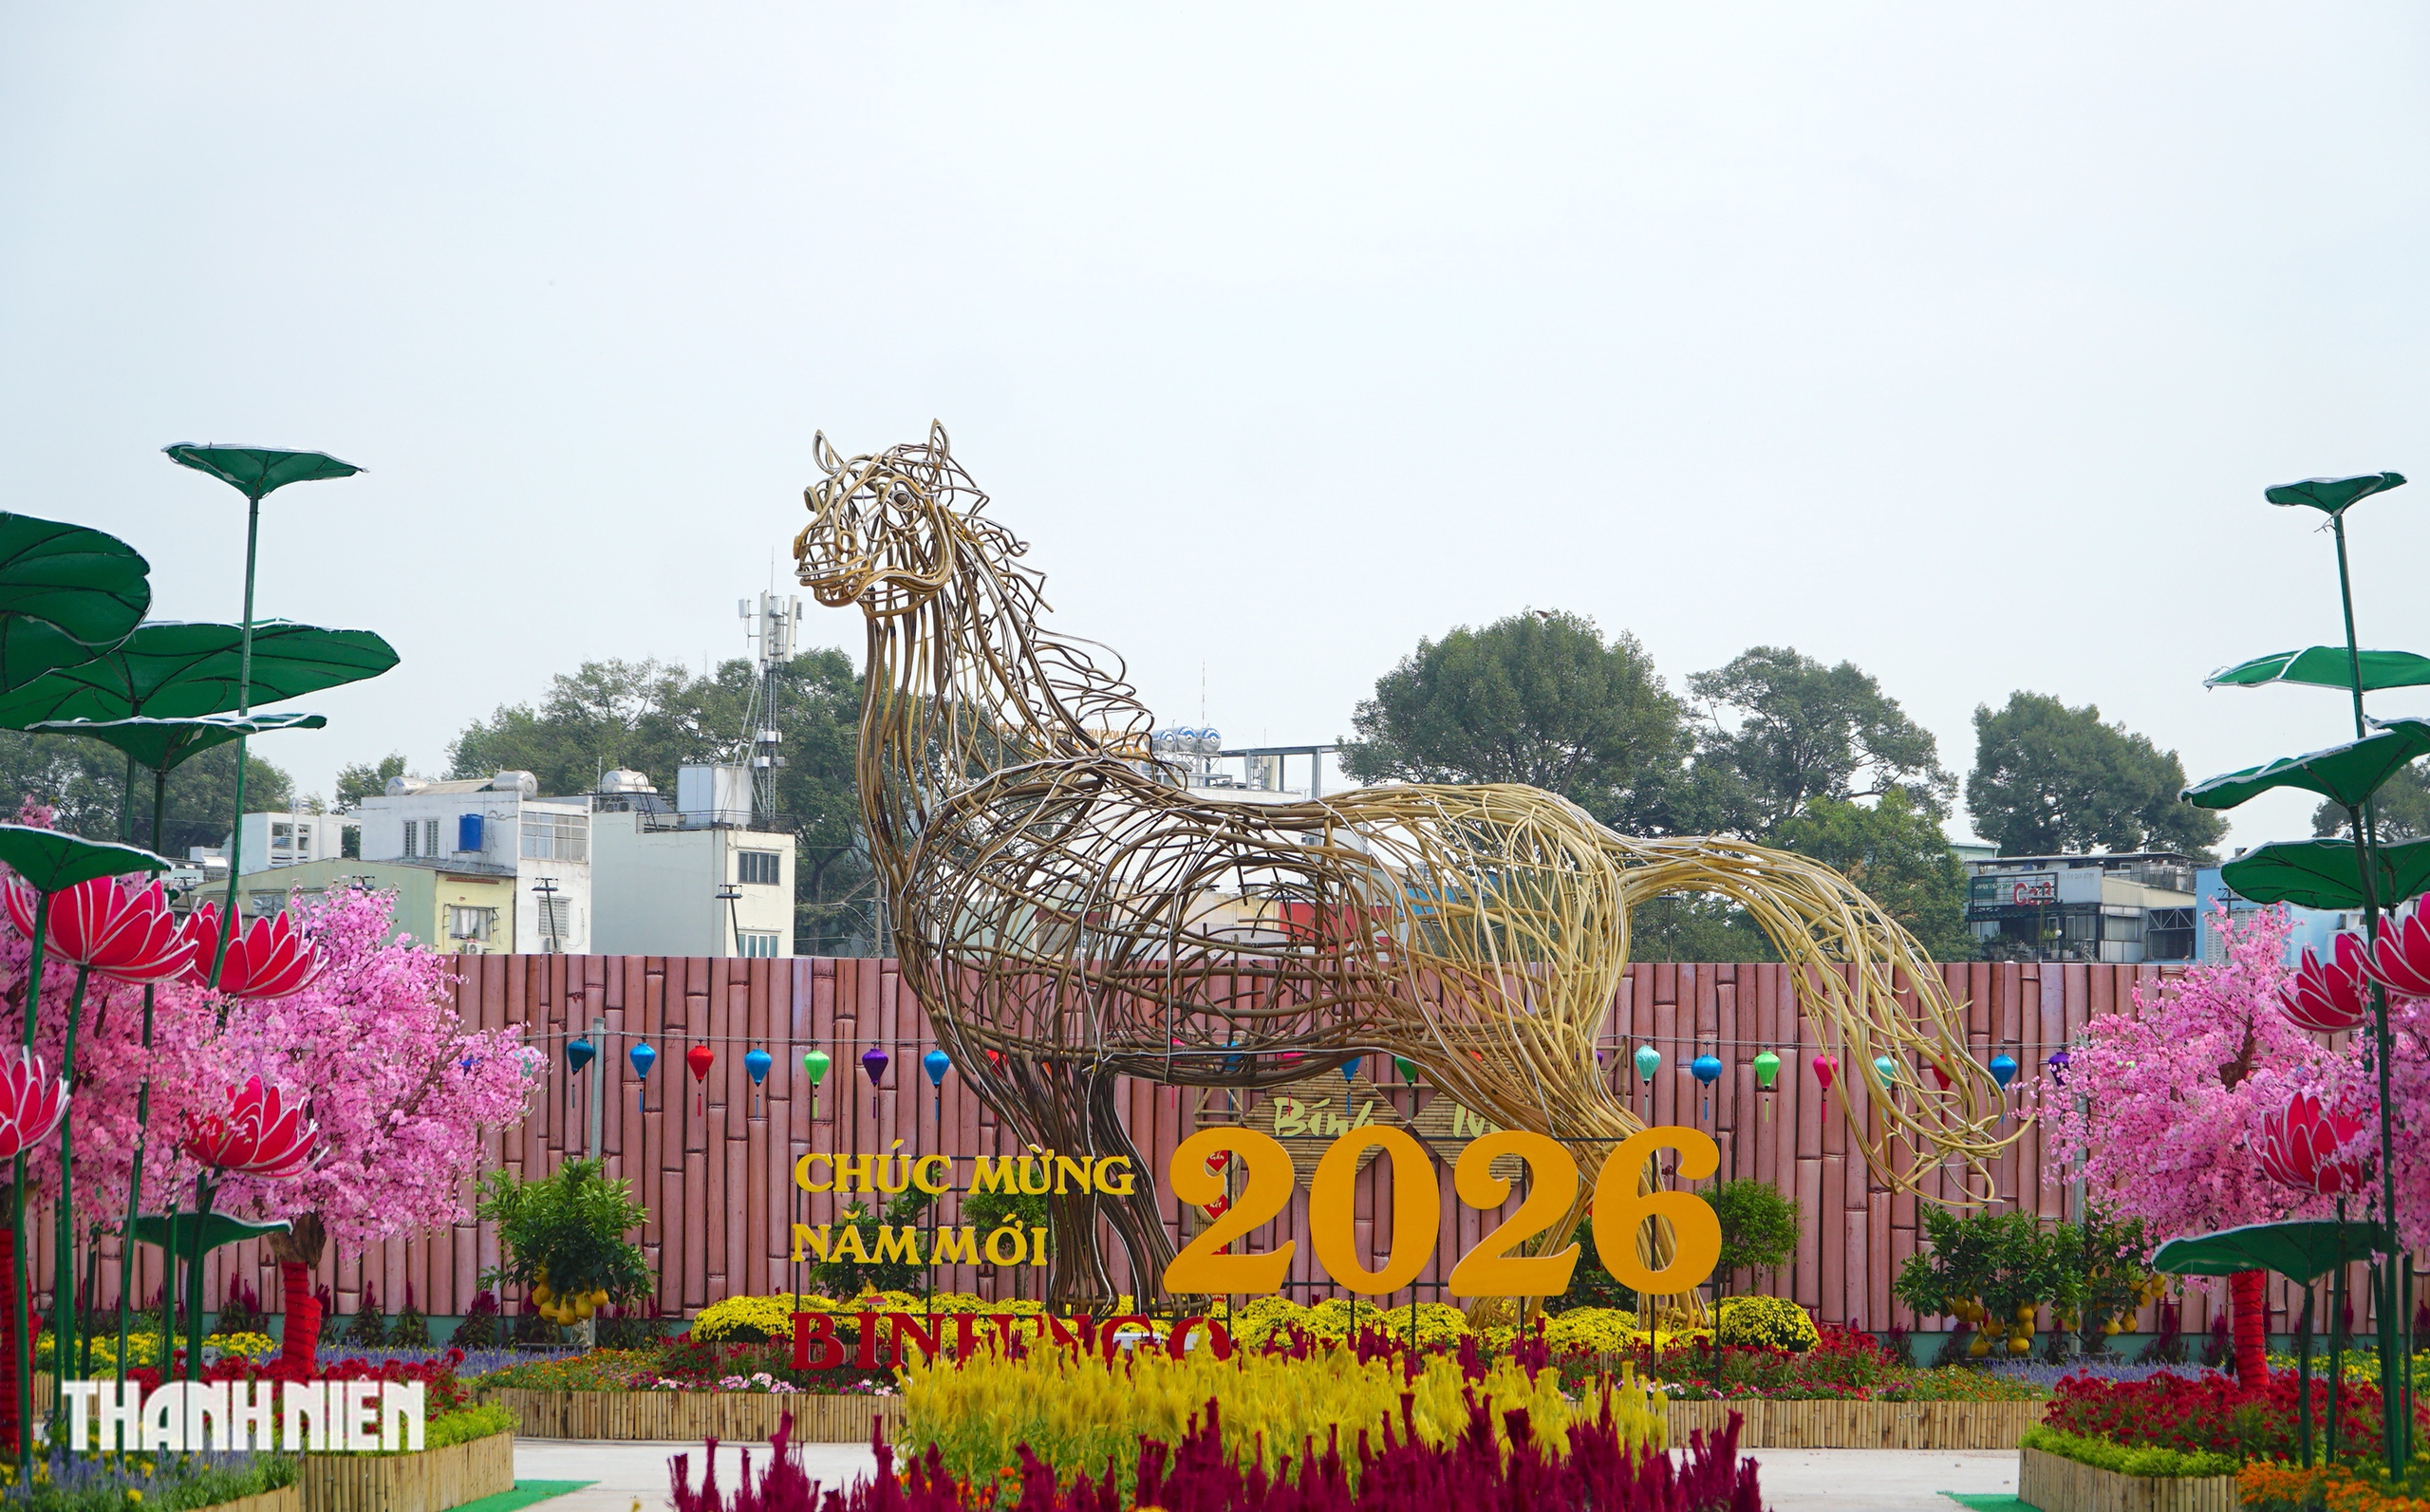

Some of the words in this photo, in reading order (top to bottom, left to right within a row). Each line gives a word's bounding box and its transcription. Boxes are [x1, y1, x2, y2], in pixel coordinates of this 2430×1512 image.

[1273, 1097, 1374, 1137] Bính
[794, 1139, 953, 1195] CHÚC
[966, 1144, 1135, 1196] MỪNG
[791, 1210, 923, 1266] NĂM
[929, 1213, 1049, 1267] MỚI
[1163, 1126, 1723, 1297] 2026
